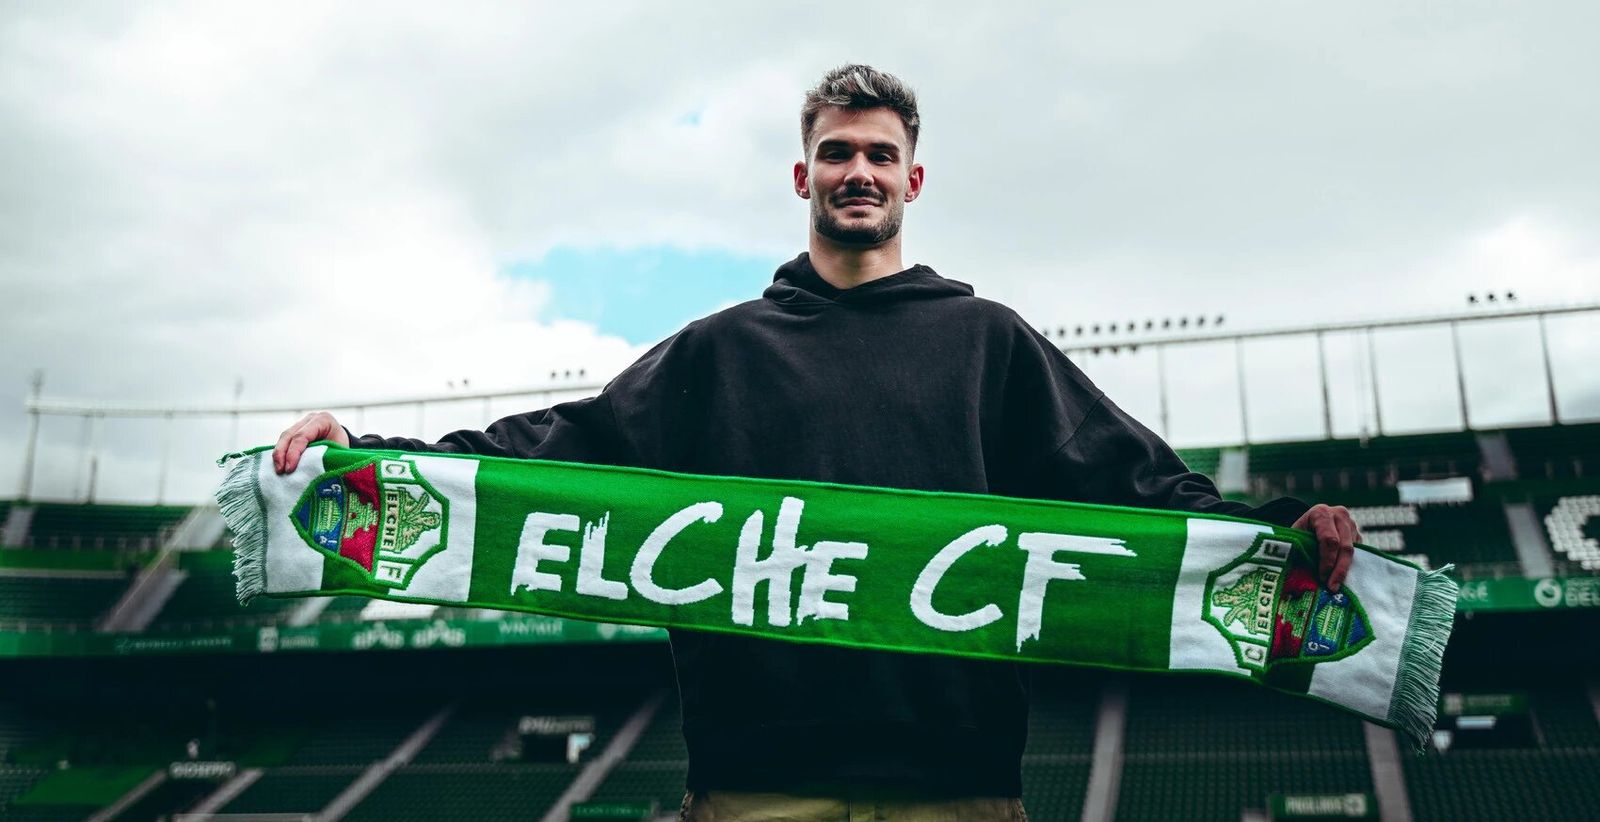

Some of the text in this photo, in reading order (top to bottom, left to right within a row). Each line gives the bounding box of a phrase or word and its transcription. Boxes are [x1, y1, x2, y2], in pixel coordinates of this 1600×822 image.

[383, 493, 398, 547] ELCHE
[510, 496, 1137, 653] ELCHE CF
[1257, 572, 1276, 629] ELCHE
